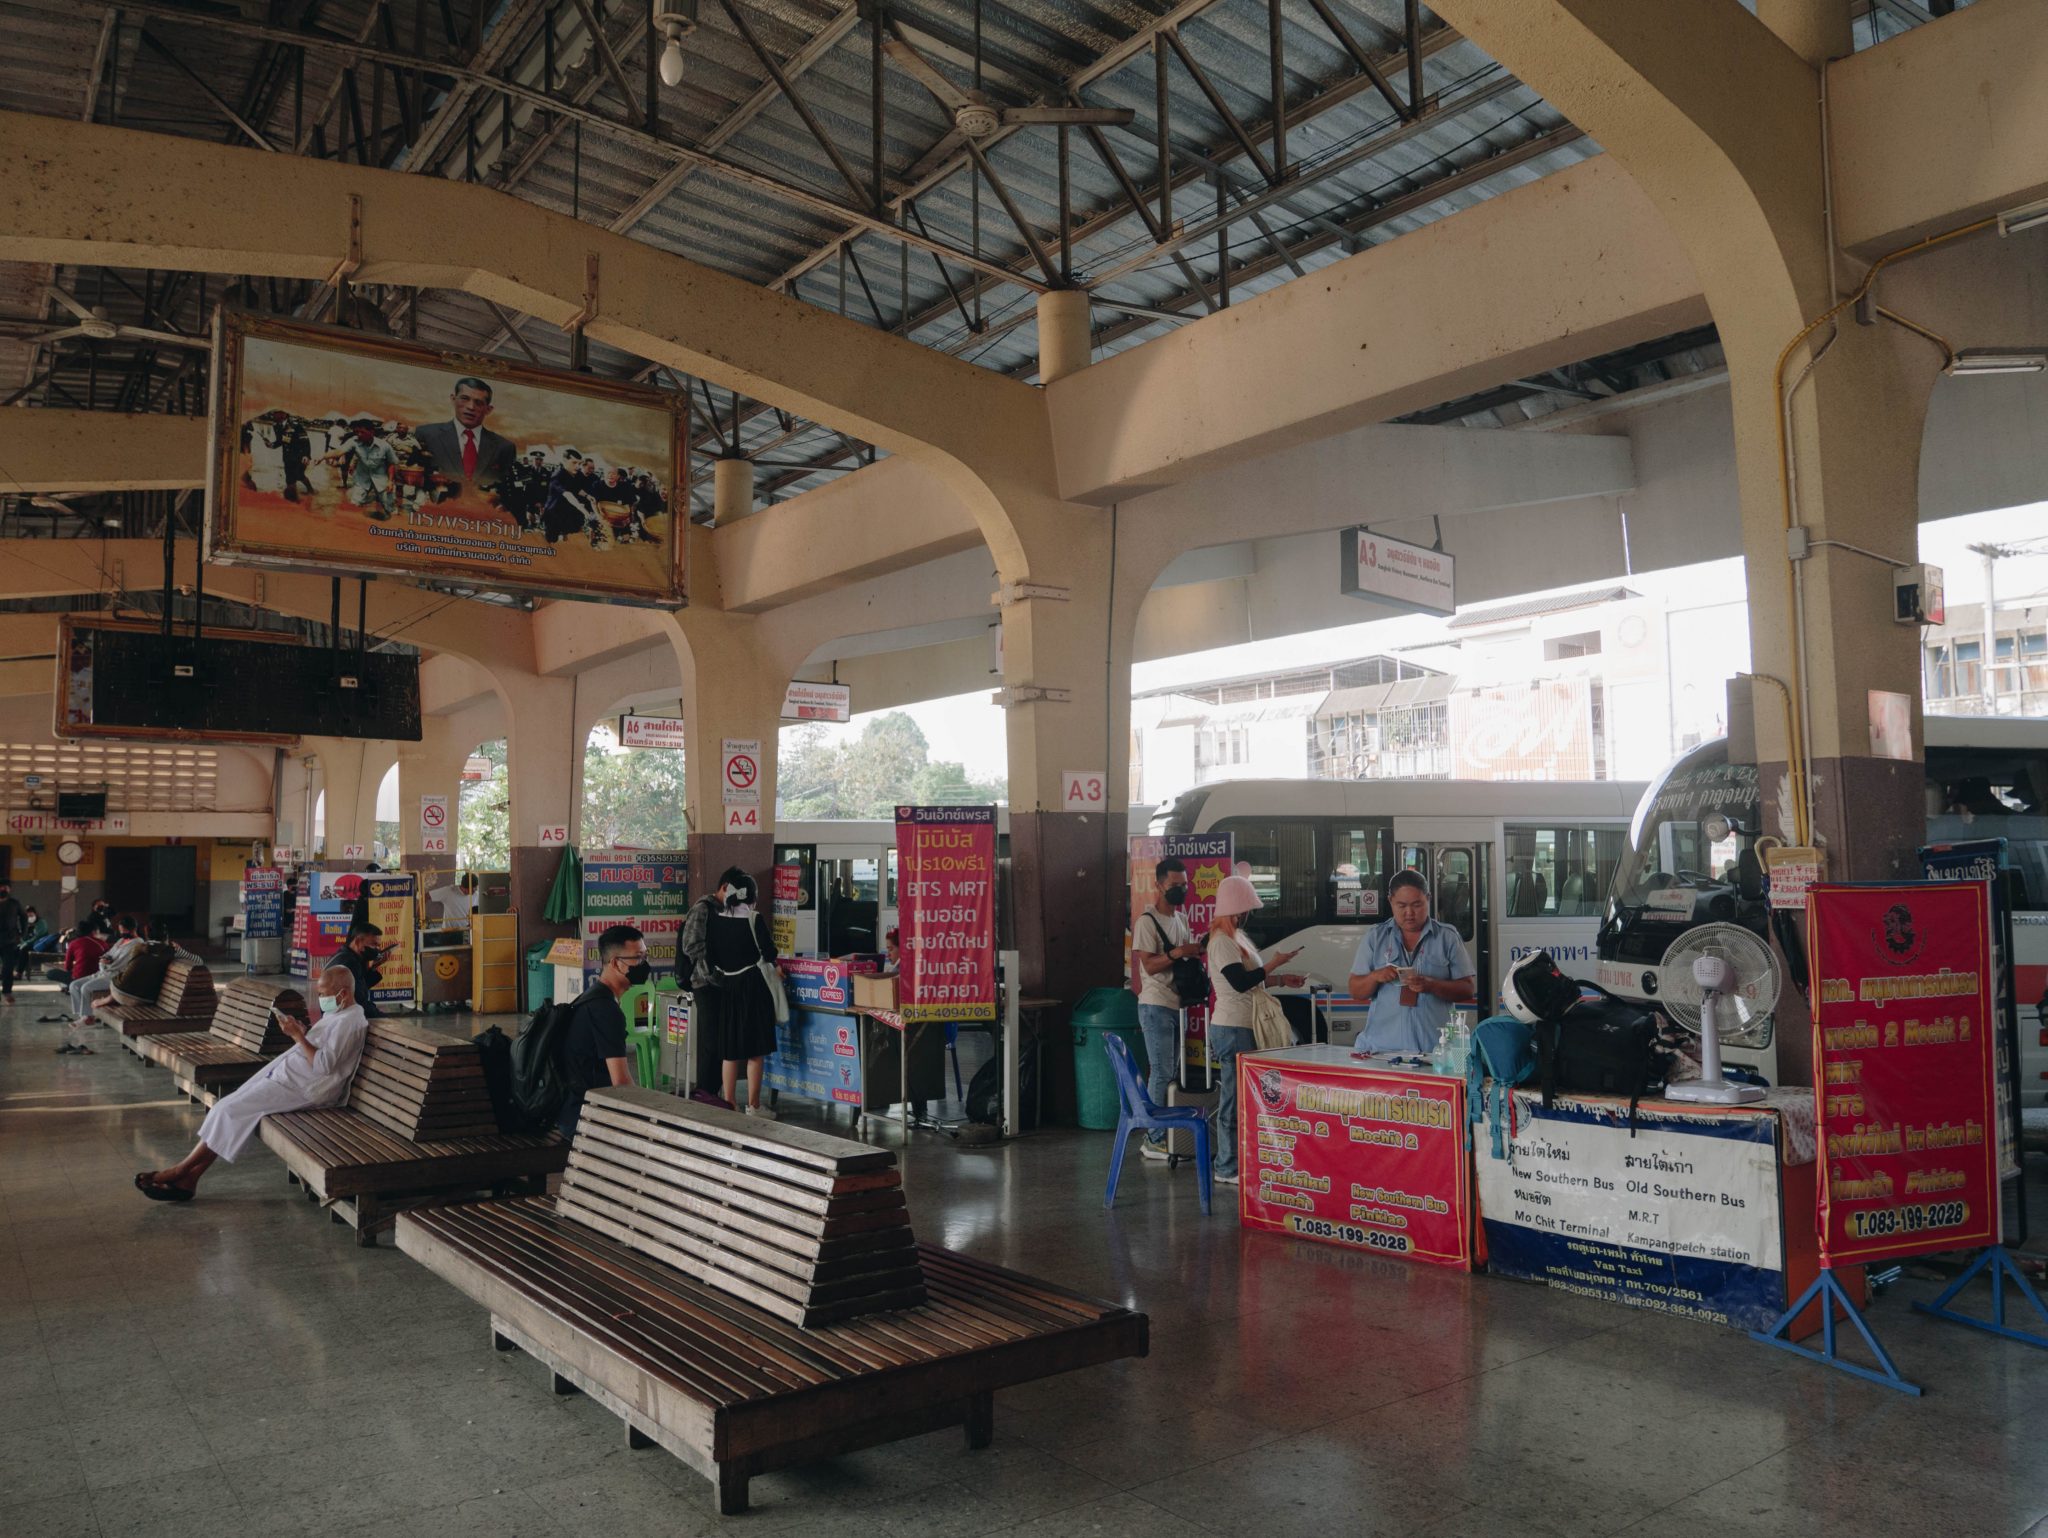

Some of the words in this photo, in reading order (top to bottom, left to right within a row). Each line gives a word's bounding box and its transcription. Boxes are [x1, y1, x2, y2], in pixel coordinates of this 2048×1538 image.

[1359, 539, 1377, 568] A3
[627, 720, 640, 734] A6
[1067, 779, 1102, 802] A3
[729, 809, 757, 826] A4
[542, 828, 566, 841] A5
[346, 846, 363, 856] A7
[425, 840, 445, 850] A6
[600, 865, 655, 883] หมอชิต
[661, 866, 675, 883] 2
[907, 881, 941, 897] BTS
[949, 881, 987, 897] MRT
[914, 905, 976, 923] หมอชิต
[905, 931, 989, 950] สายใต้ใหม่
[821, 991, 843, 1001] EXPRESS
[917, 984, 979, 999] ศาลายา
[1884, 1021, 1899, 1047] 2
[1959, 1016, 1972, 1041] 2
[1315, 1121, 1330, 1137] 2
[1350, 1126, 1403, 1149] Mochit
[1405, 1133, 1419, 1150] 2
[1258, 1147, 1293, 1167] BTS
[1624, 1149, 1693, 1174] สายใต้เก่า
[1512, 1165, 1532, 1179] New
[1536, 1170, 1589, 1188] Southern
[1593, 1176, 1615, 1191] Bus
[1351, 1182, 1374, 1202] New
[1375, 1185, 1424, 1210] Southern
[1425, 1195, 1449, 1214] Bus
[1514, 1188, 1551, 1206] หมอชิต
[1626, 1180, 1648, 1194] Old
[1653, 1184, 1716, 1203] Southern
[1721, 1193, 1746, 1209] Bus
[1350, 1205, 1407, 1227] Pinklao
[1514, 1210, 1532, 1223] Mo
[1535, 1214, 1556, 1229] Chit
[1560, 1219, 1610, 1238] Terminal
[1628, 1209, 1660, 1224] M.R.T
[1855, 1201, 1964, 1238] T.083-199-2028
[1293, 1216, 1407, 1251] T.083-199-2028
[1627, 1231, 1706, 1254] Kampangpetch
[1710, 1245, 1751, 1261] station
[1593, 1259, 1617, 1272] Van
[1618, 1264, 1644, 1276] Taxi
